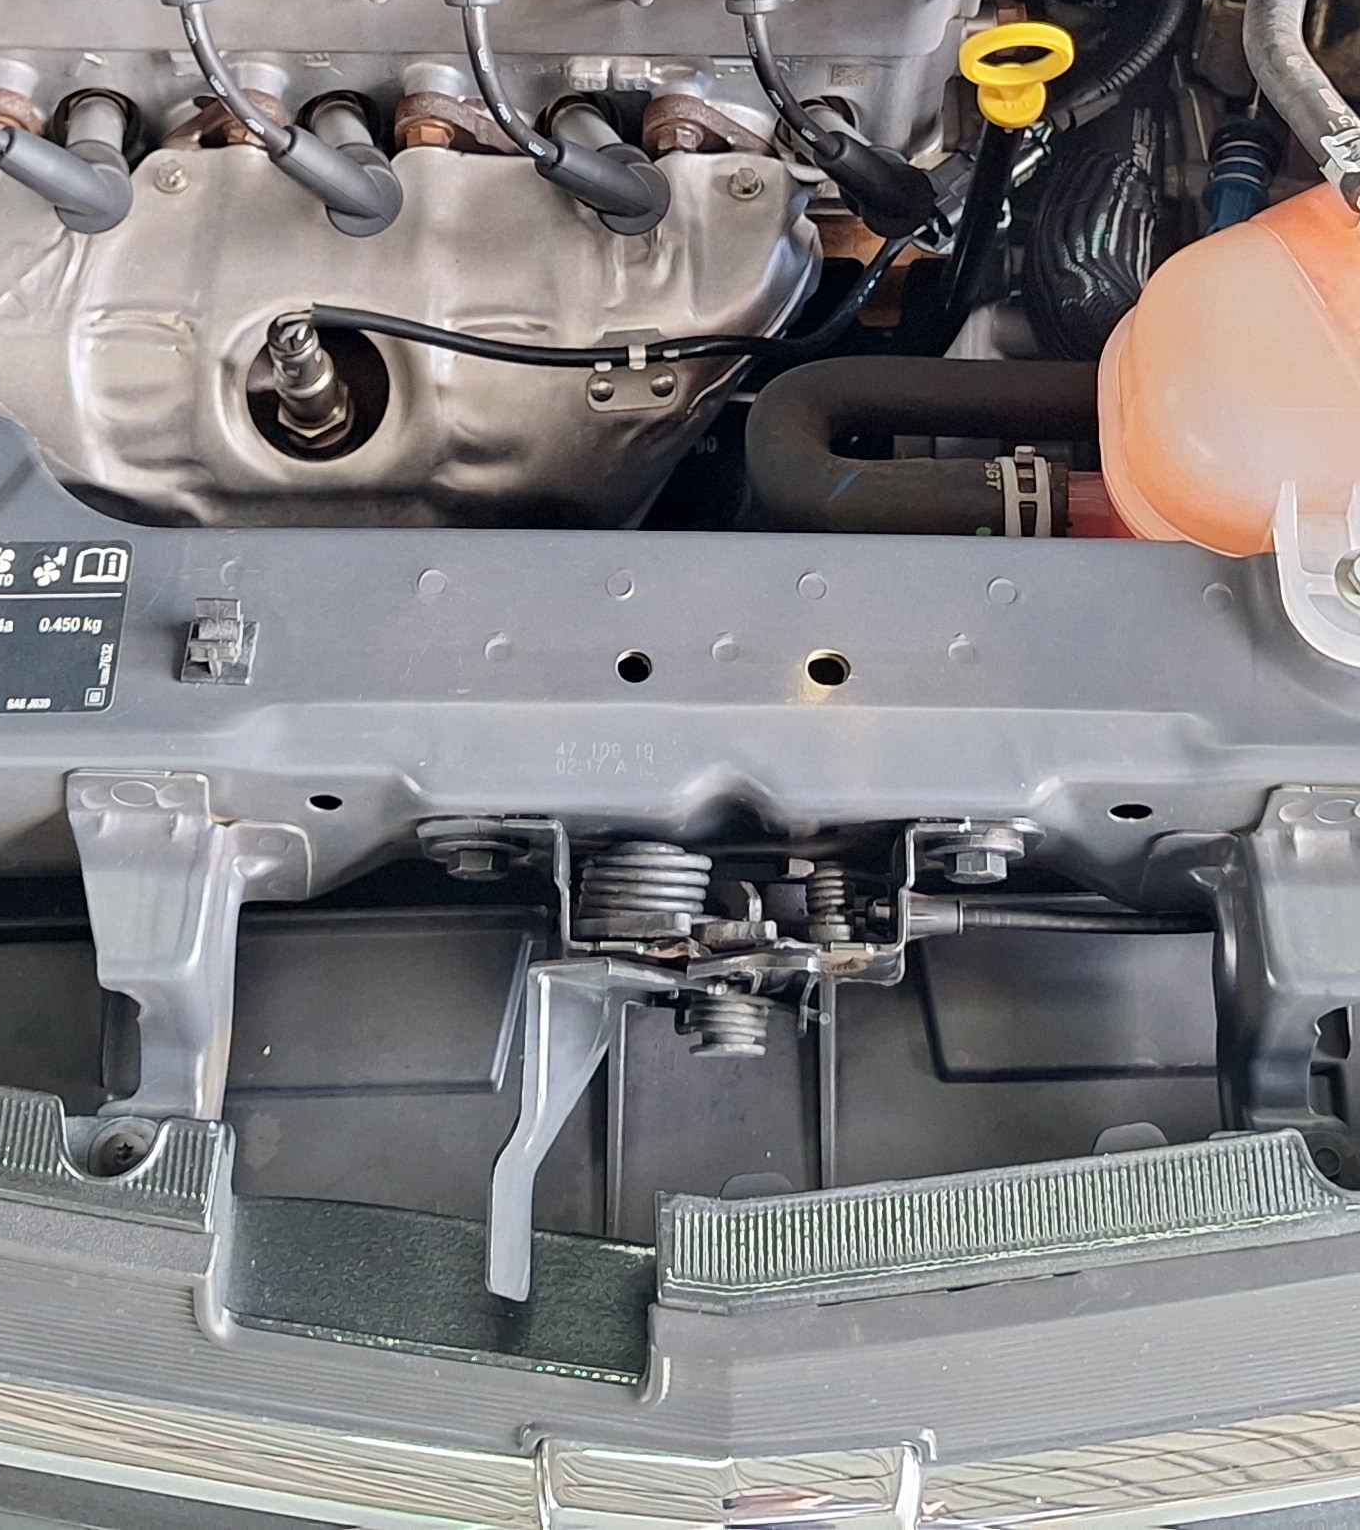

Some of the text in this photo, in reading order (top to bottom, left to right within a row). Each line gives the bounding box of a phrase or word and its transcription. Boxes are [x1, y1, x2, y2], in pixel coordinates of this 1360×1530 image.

[984, 462, 1001, 491] SGT
[82, 616, 103, 635] kg
[6, 697, 27, 710] SAE
